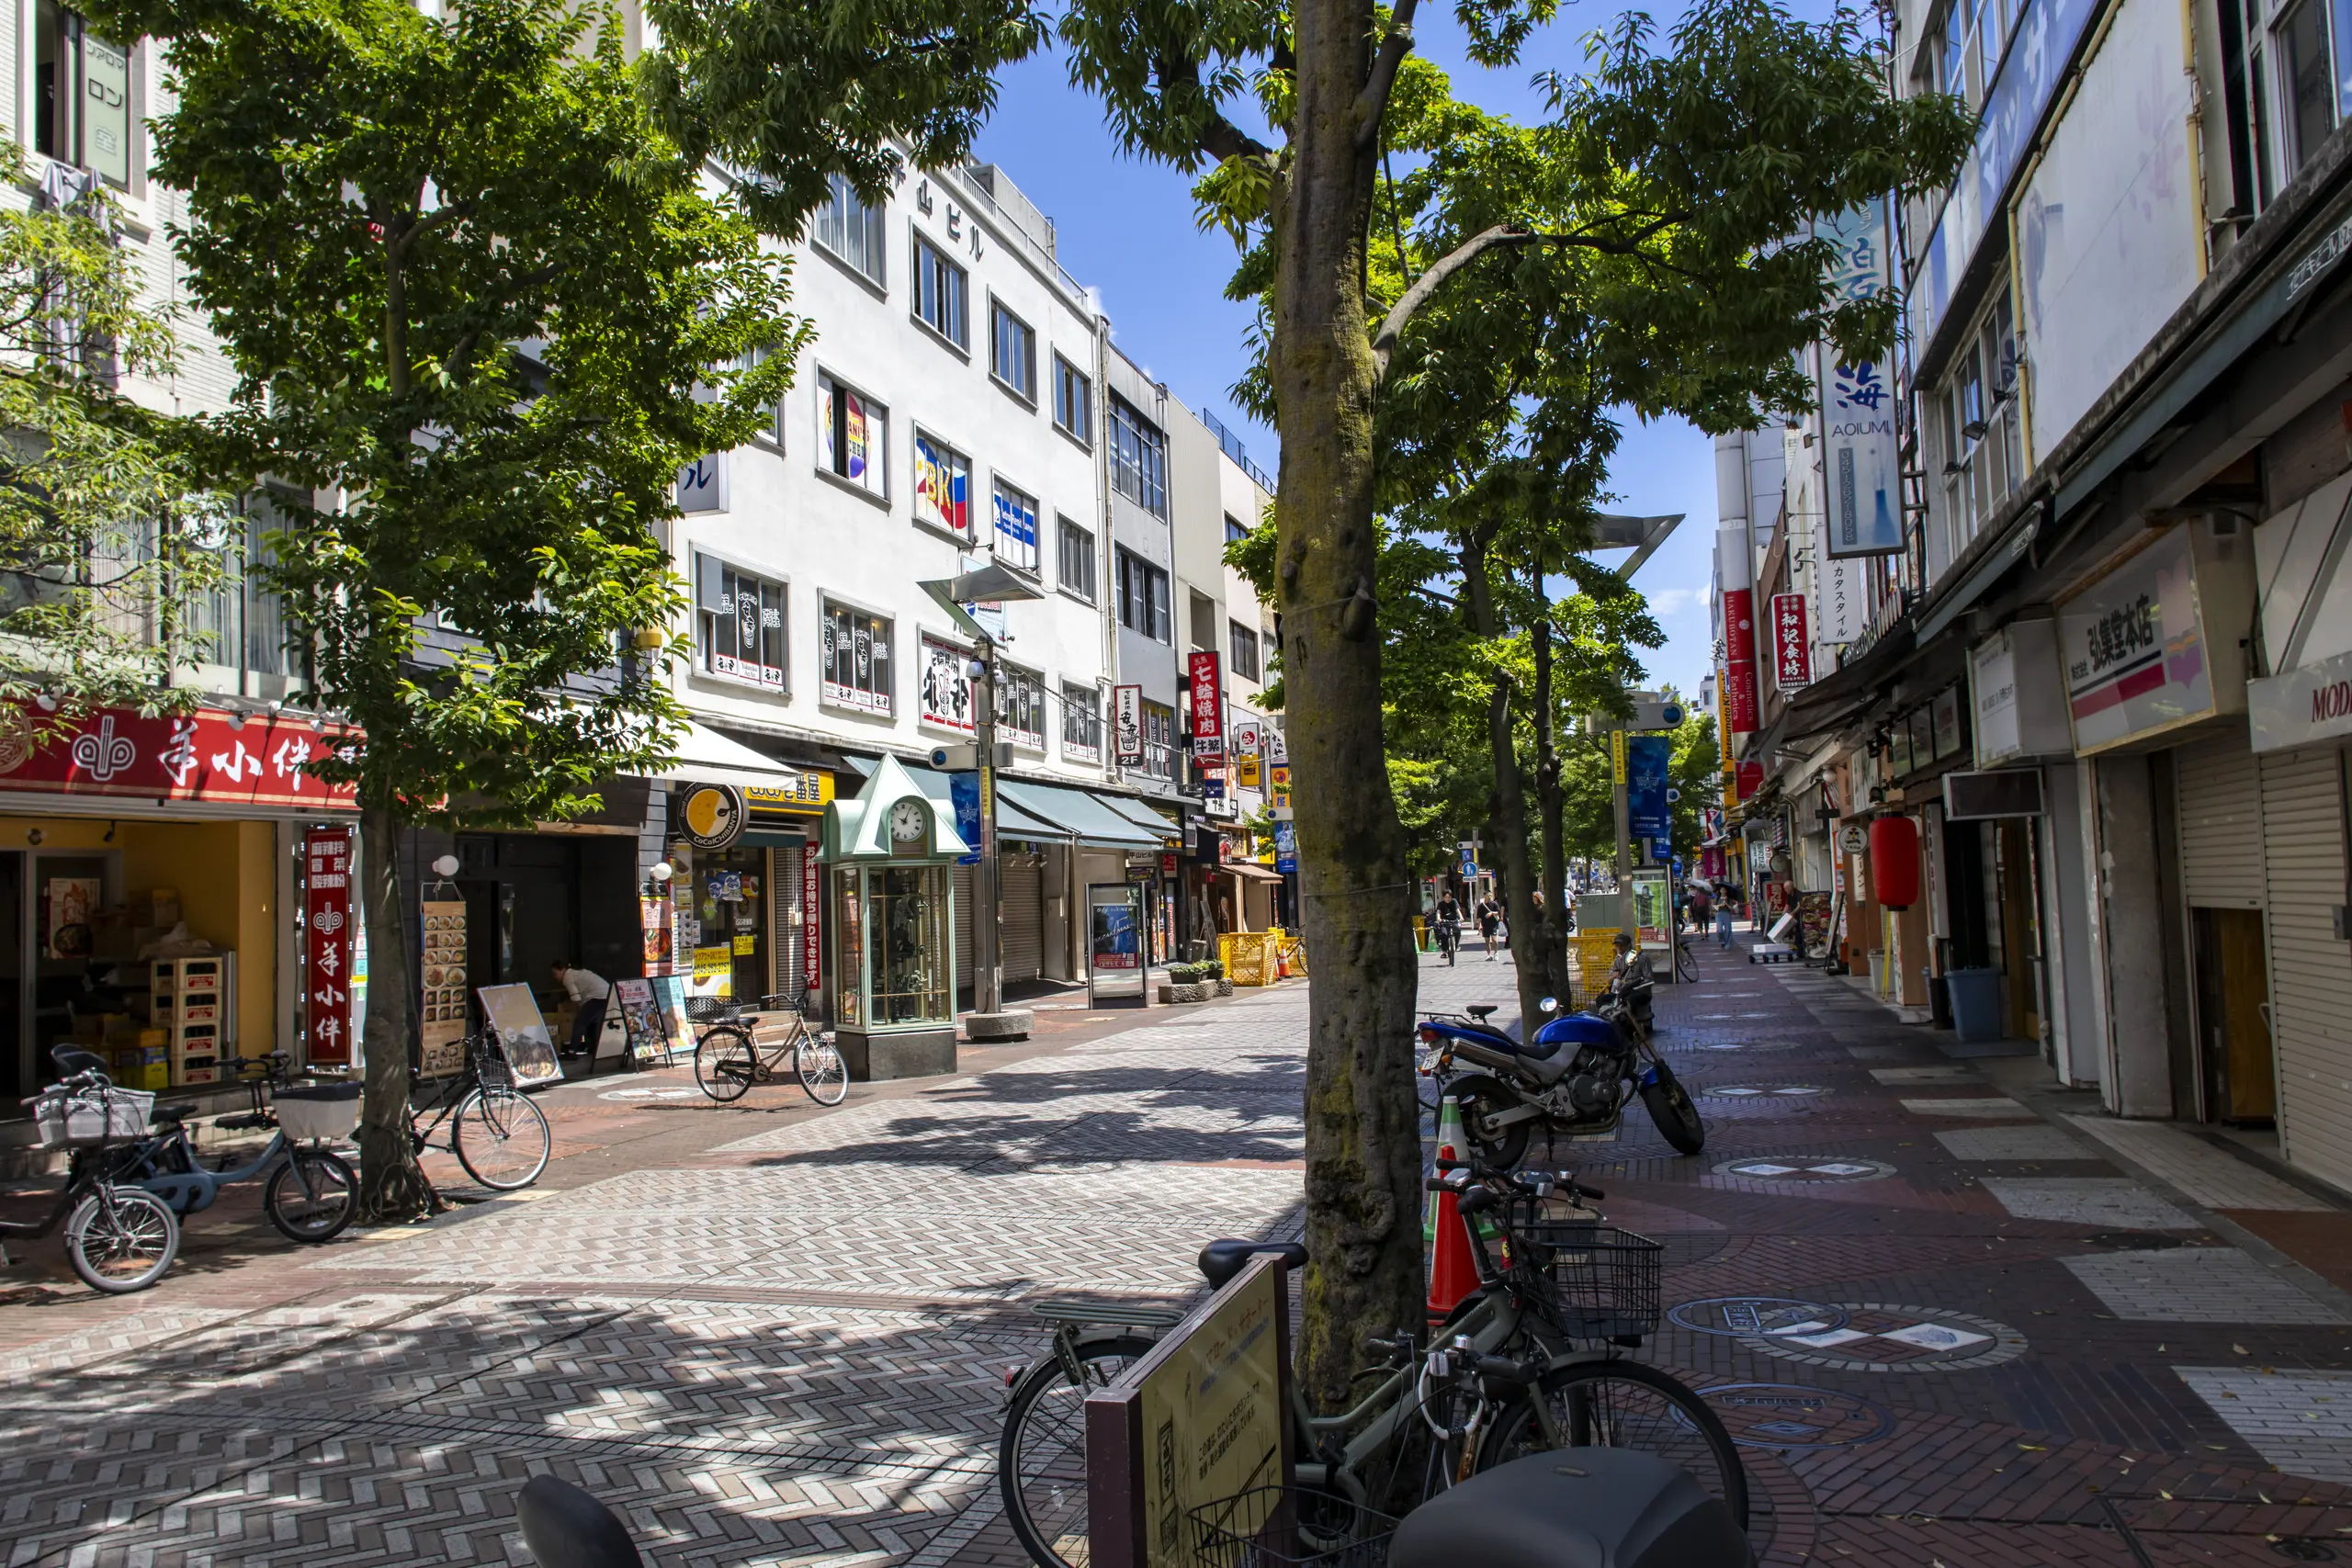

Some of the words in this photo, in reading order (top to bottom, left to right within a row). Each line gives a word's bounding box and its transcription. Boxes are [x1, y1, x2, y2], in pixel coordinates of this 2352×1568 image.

[1831, 420, 1891, 438] AOIUMI
[926, 461, 952, 511] BK
[1726, 595, 1737, 657] HAKUBOTAN
[1781, 612, 1800, 676] 和記食坊
[2086, 593, 2154, 673] 弘集堂本店
[1195, 665, 1216, 734] 七輪焼肉
[1730, 675, 1738, 721] Esthetics
[1745, 671, 1753, 722] Cosmetics
[1121, 755, 1138, 764] 2F
[1725, 705, 1734, 761] Matsumoto
